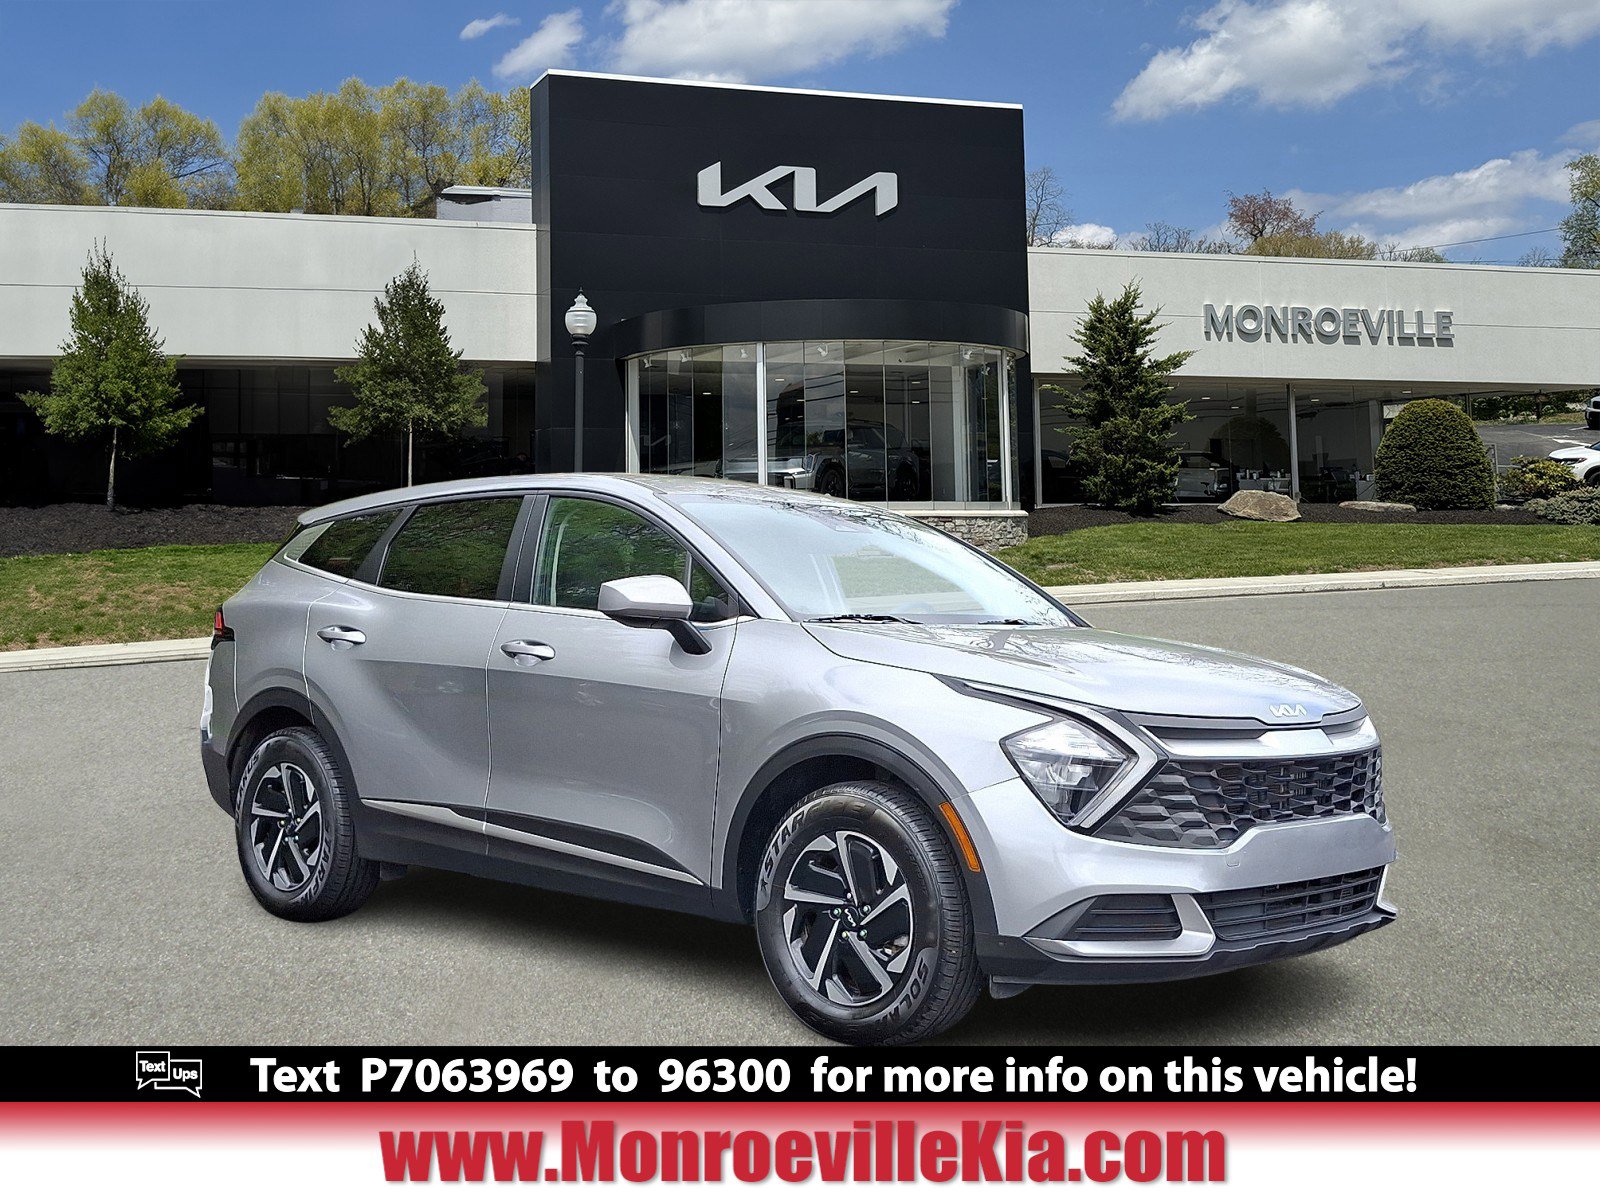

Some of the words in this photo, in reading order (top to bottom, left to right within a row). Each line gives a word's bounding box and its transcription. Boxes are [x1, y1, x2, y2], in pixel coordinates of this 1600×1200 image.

[697, 161, 898, 216] KIA
[1203, 304, 1455, 346] MONROEVILLE
[1269, 703, 1307, 718] KIA
